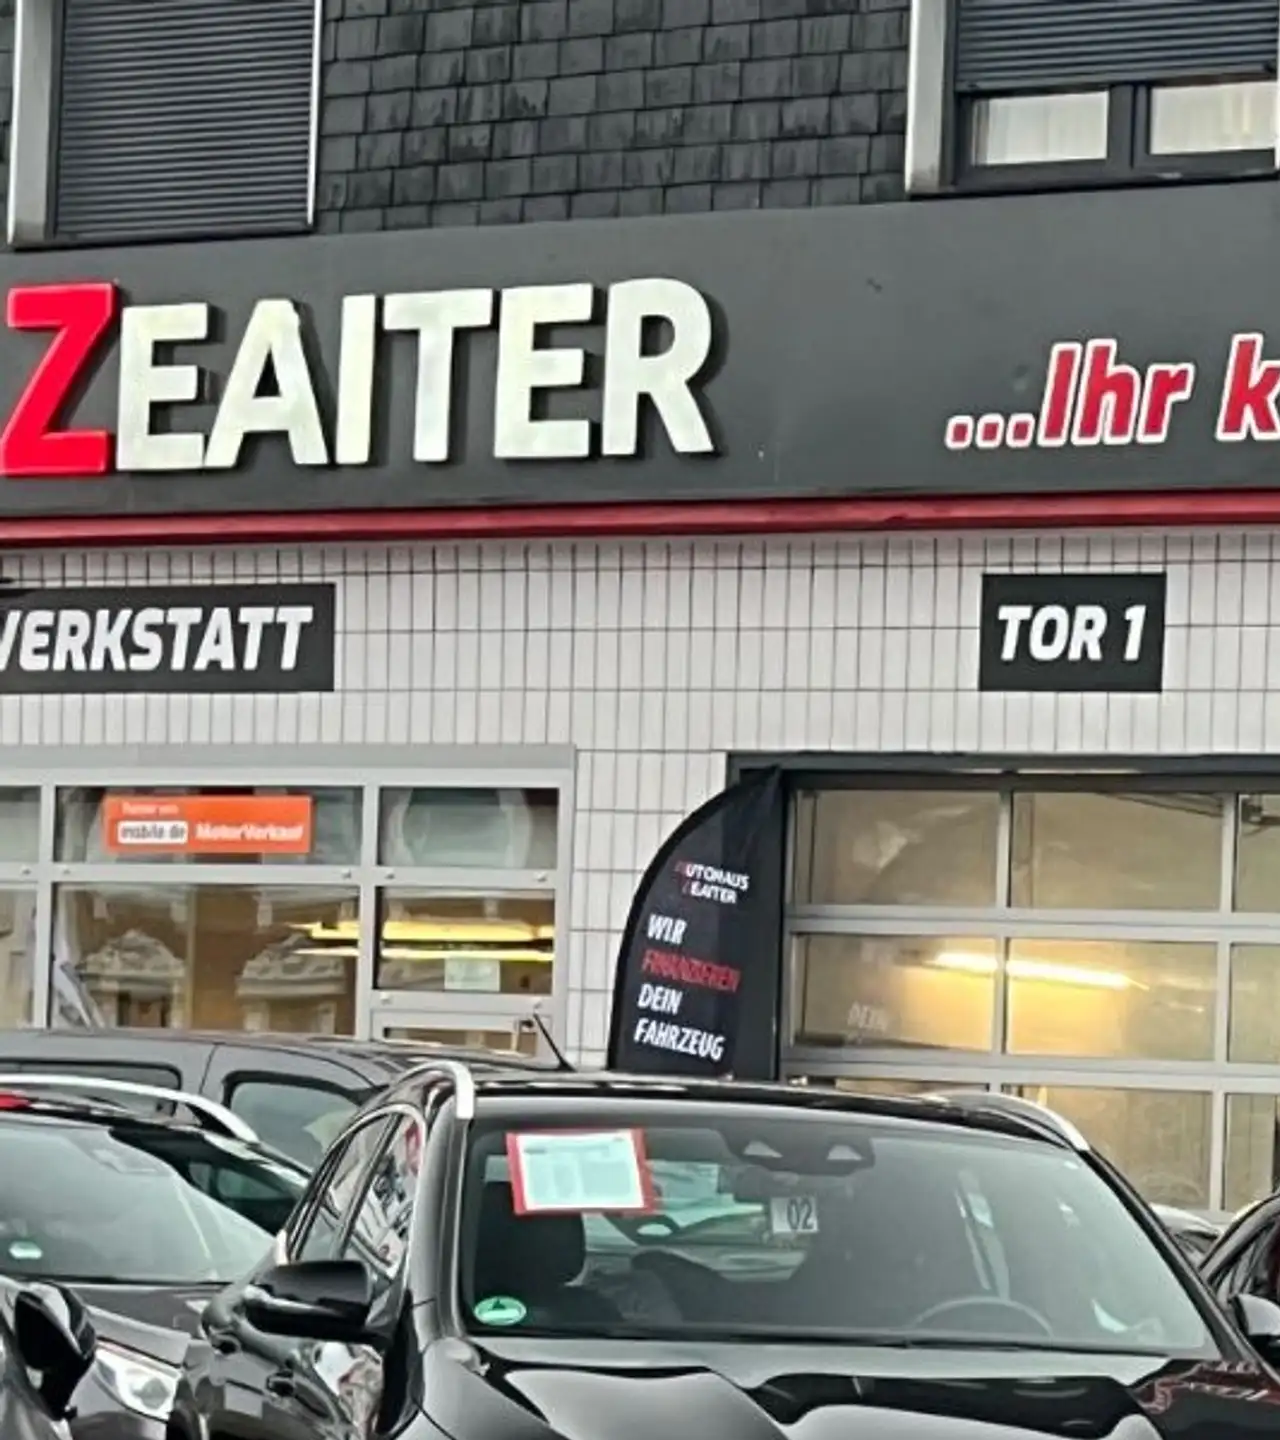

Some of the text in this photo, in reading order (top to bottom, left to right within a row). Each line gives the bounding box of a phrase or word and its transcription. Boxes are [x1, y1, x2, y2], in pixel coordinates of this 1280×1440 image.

[1, 277, 716, 477] ZEAITER
[998, 604, 1147, 661] TOR 1
[647, 913, 687, 945] WIR
[637, 983, 683, 1015] DEIN
[633, 1017, 726, 1062] FAHRZEUG
